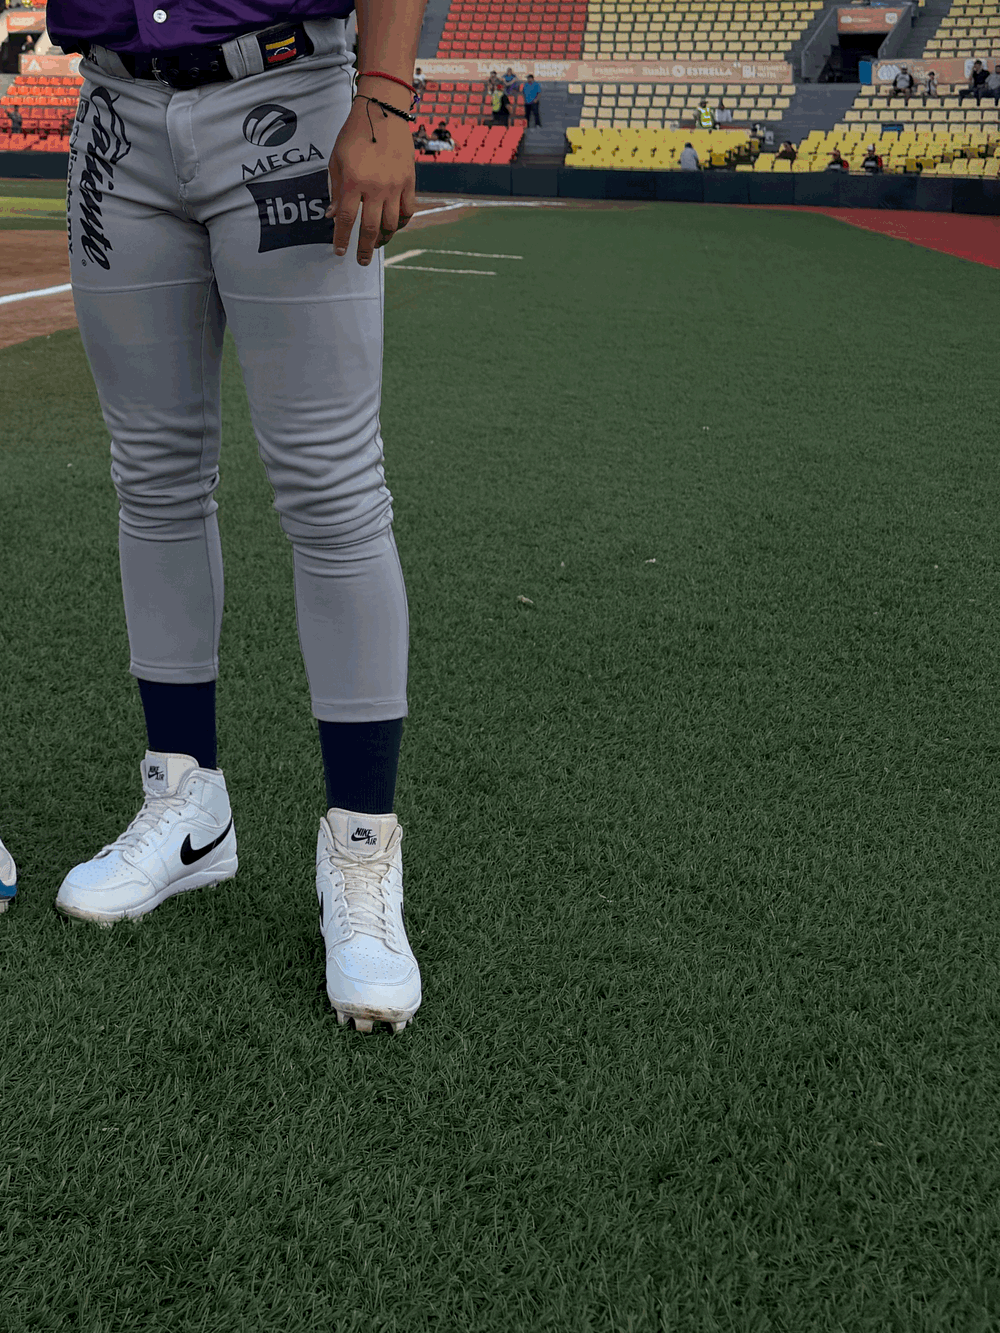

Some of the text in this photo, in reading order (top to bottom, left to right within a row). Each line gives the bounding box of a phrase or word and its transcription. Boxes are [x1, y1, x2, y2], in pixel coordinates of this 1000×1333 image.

[686, 67, 732, 76] ESTRELLA
[241, 143, 325, 180] MEGA
[265, 192, 326, 226] ibis
[355, 827, 373, 837] NIKE
[365, 837, 377, 846] AIR
